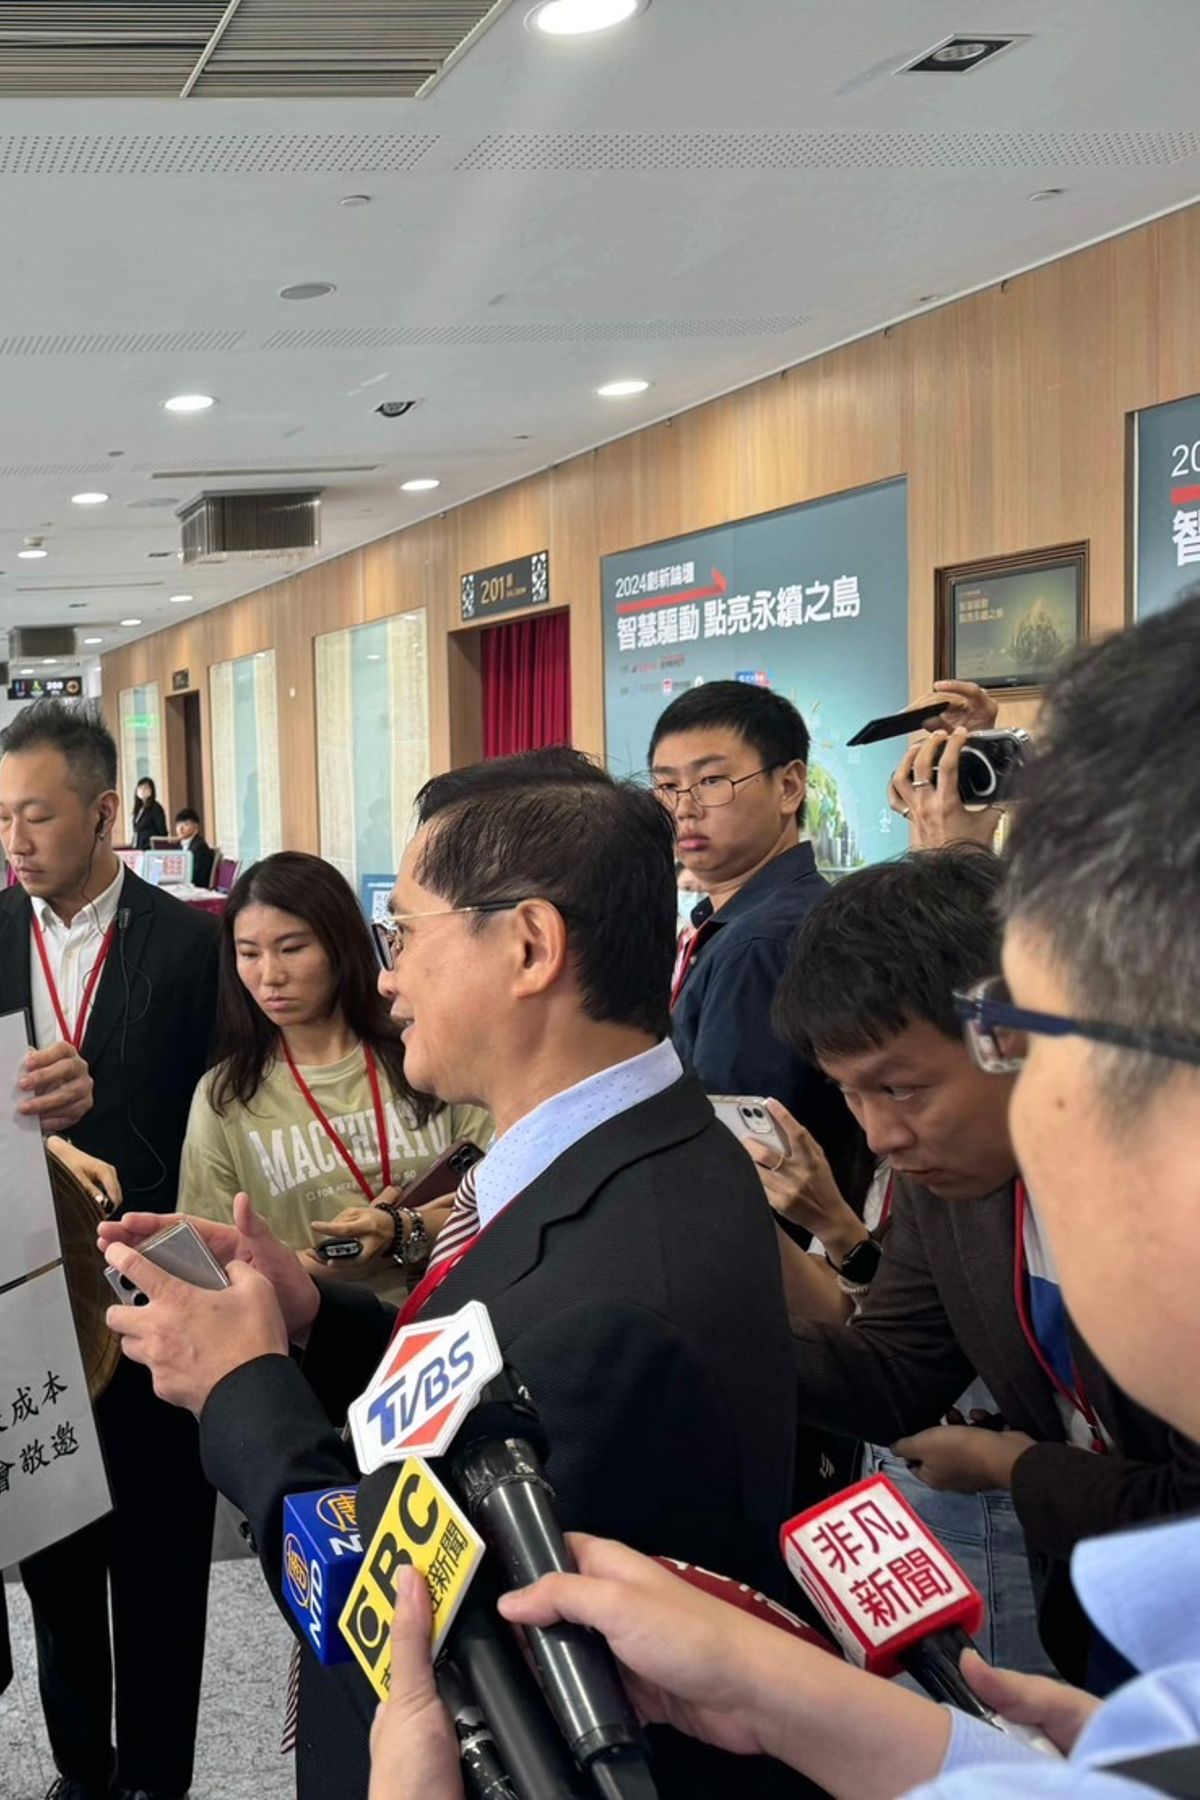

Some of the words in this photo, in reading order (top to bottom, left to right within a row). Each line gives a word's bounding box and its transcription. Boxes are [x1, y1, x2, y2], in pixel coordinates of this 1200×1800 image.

[481, 576, 505, 605] 201
[617, 603, 699, 652] 智慧驅動
[703, 575, 861, 639] 點亮永續之島
[367, 1331, 474, 1447] TVBS
[812, 1500, 910, 1573] 非凡
[849, 1547, 952, 1627] 新聞
